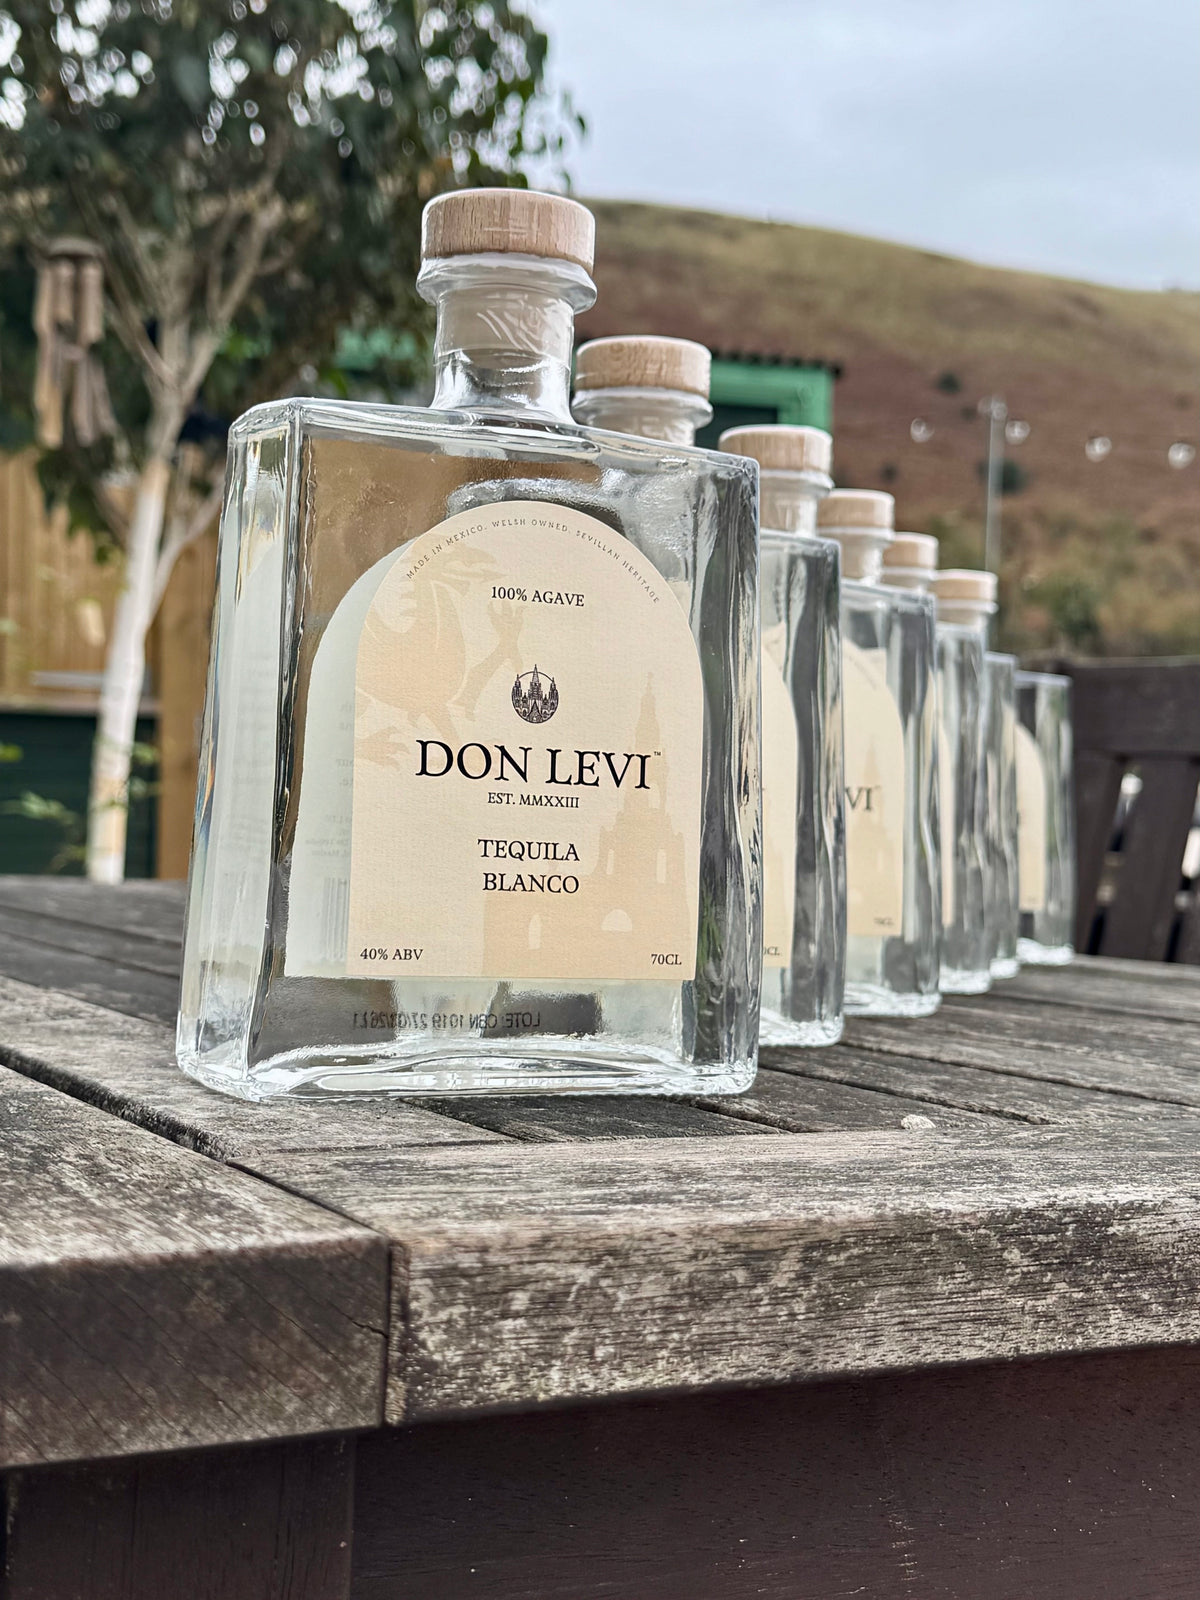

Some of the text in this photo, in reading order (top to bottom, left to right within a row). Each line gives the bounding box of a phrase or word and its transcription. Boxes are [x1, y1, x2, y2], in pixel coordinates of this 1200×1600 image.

[406, 554, 430, 579] MADE
[431, 543, 443, 556] IN
[491, 518, 526, 528] WELSH
[575, 529, 621, 560] SEVILLAN
[621, 559, 661, 604] HERITAGE
[490, 586, 586, 607] 100% AGAVE
[415, 739, 533, 783] DON
[545, 747, 652, 789] LEVI
[487, 792, 580, 808] EST. MMXXIII
[477, 839, 581, 861] TEQUILA
[482, 872, 580, 894] BLANCO
[359, 947, 424, 961] 40% ABV
[650, 953, 683, 966] 70CL
